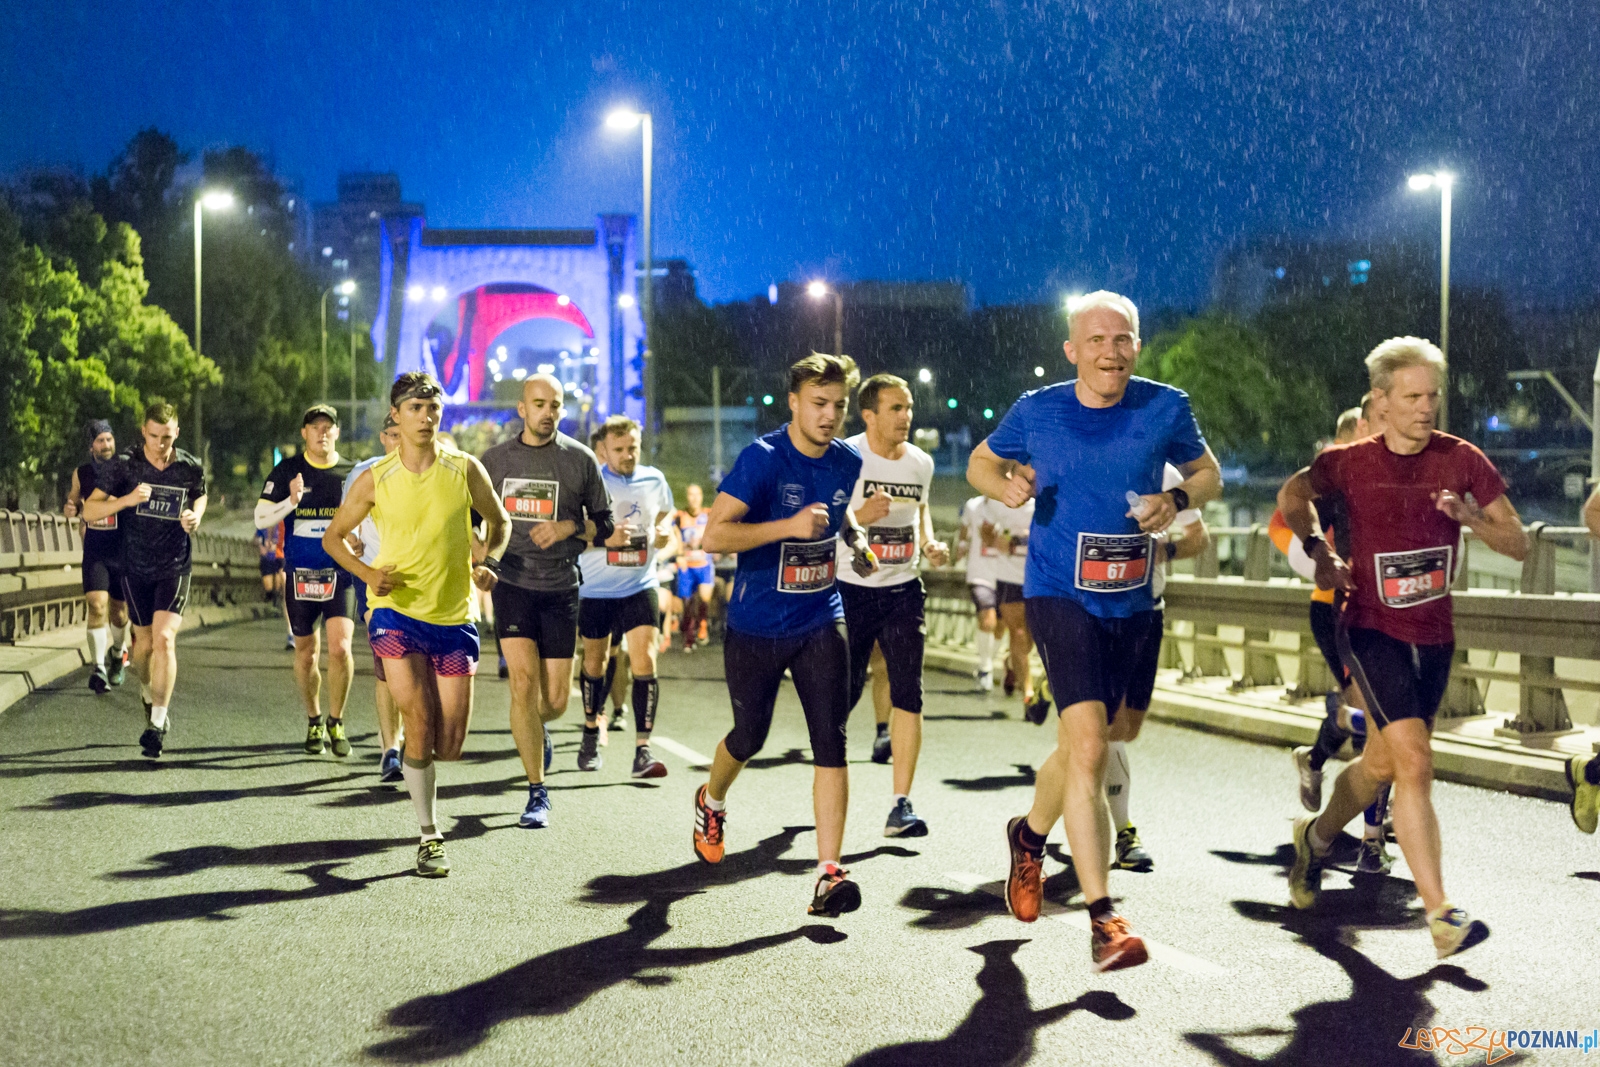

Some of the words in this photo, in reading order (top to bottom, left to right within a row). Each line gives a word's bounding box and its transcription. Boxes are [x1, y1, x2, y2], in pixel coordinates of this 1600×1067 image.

[149, 499, 171, 512] 8177
[515, 499, 541, 512] 8611
[882, 545, 906, 558] 7147
[795, 564, 829, 582] 10738
[1107, 563, 1127, 579] 67
[1397, 574, 1433, 596] 2243
